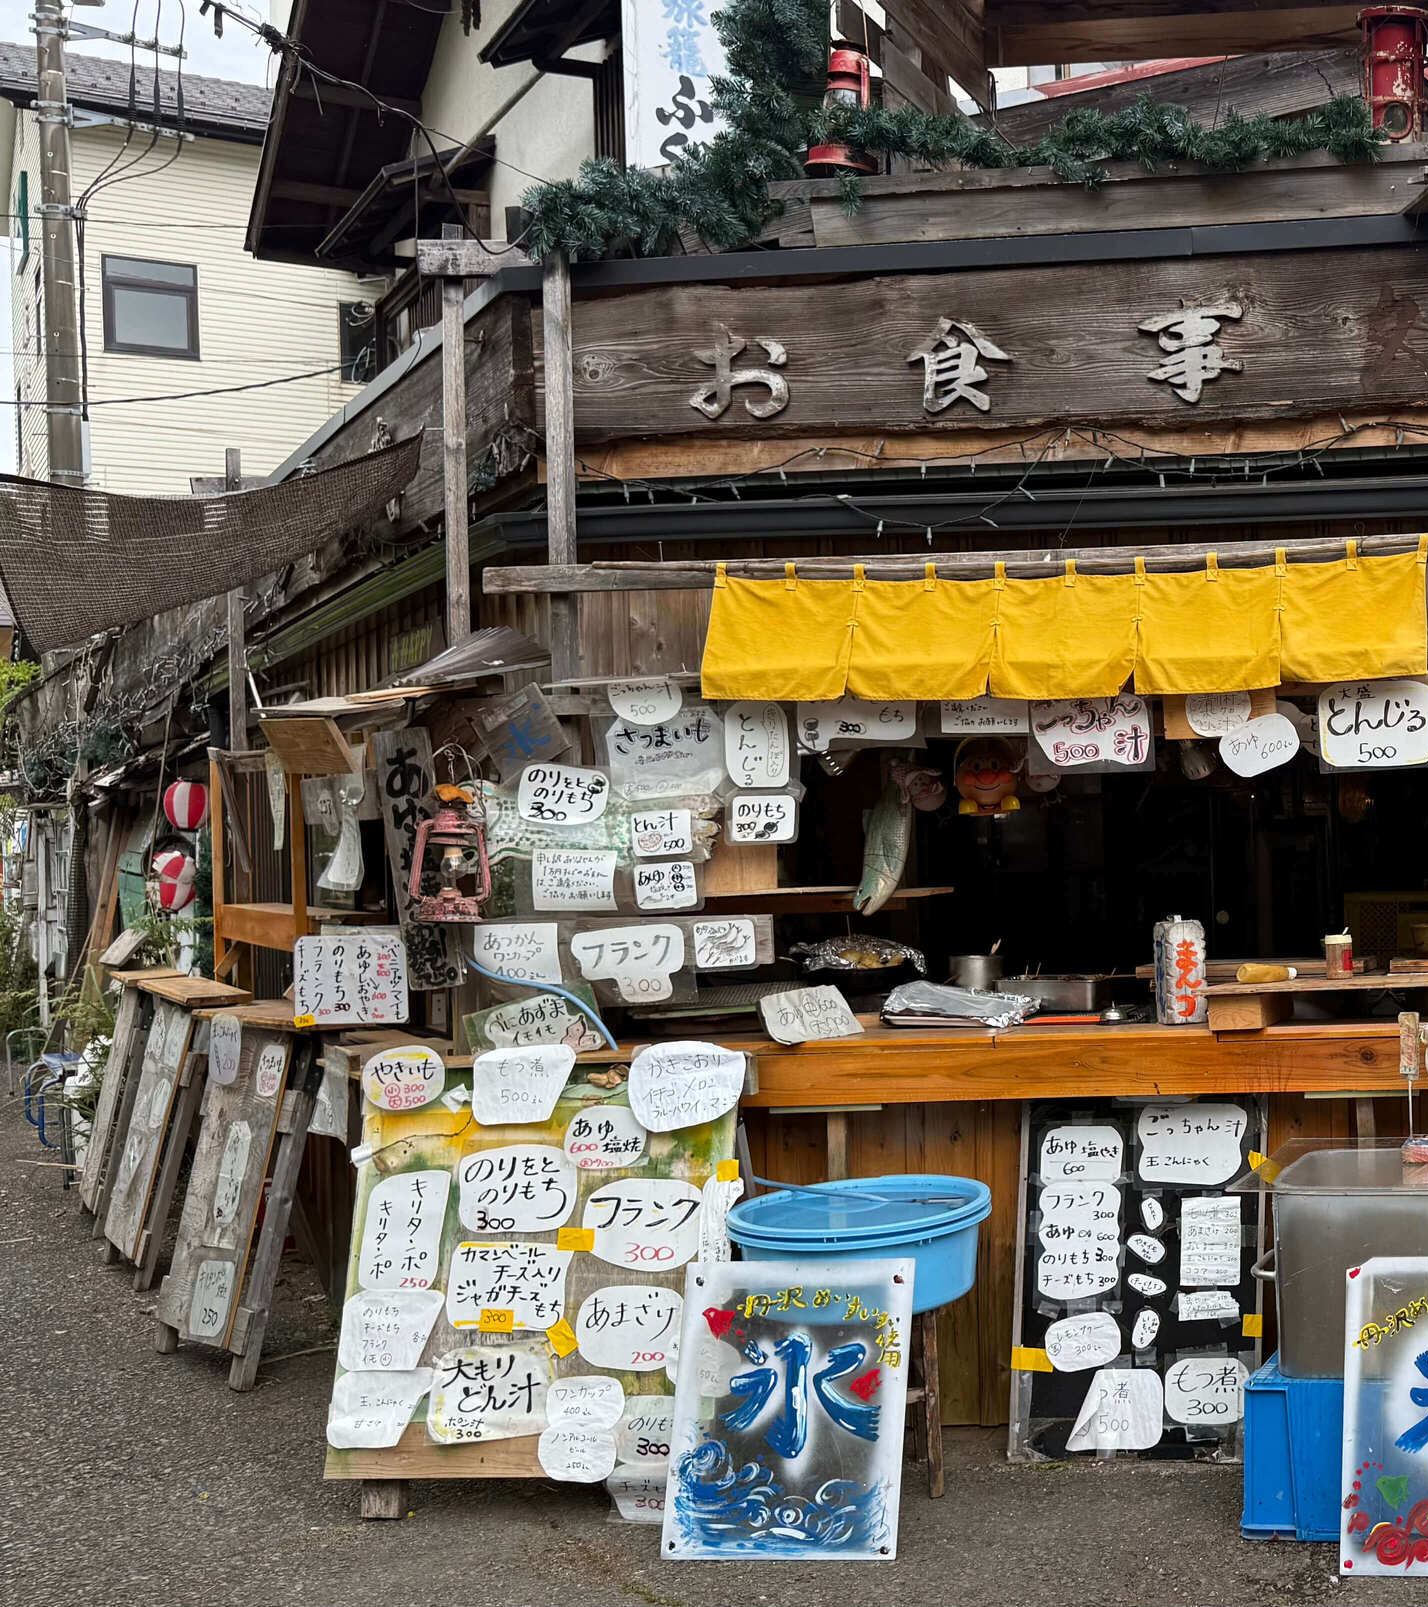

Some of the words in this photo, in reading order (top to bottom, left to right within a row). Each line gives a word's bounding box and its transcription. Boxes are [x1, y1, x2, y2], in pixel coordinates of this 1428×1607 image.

[1339, 684, 1376, 700] 大盛
[631, 704, 657, 717] 500
[615, 718, 711, 755] さつまいも
[1114, 726, 1149, 761] 汁
[738, 713, 763, 787] とんじる
[1053, 741, 1100, 763] 500
[1357, 742, 1397, 763] 500
[533, 787, 594, 812] のりもち
[528, 801, 568, 821] 300
[738, 803, 787, 820] のりもち
[634, 811, 679, 833] とん汁
[736, 821, 757, 833] 300
[663, 838, 686, 851] 500
[483, 931, 544, 951] あつかん
[582, 934, 671, 968] フランク
[494, 947, 542, 961] ワンカップ
[312, 945, 324, 1014] フランク
[332, 945, 345, 1002] のりもち
[622, 977, 662, 996] 300
[334, 1002, 351, 1012] 300
[489, 998, 567, 1032] べにあずま
[512, 1024, 557, 1047] イモイモ
[370, 1058, 437, 1085] やきいも
[498, 1056, 550, 1078] もつ煮
[404, 1083, 425, 1094] 300
[405, 1095, 427, 1107] 500
[572, 1118, 614, 1141] あゆ
[1146, 1114, 1244, 1138] ごっちゃん汁
[569, 1142, 599, 1155] 600
[602, 1135, 642, 1153] 塩焼
[1046, 1136, 1120, 1159] あゆ塩やき
[465, 1156, 560, 1183] のりをと
[1063, 1162, 1086, 1175] 600
[478, 1177, 567, 1220] のりもち
[1046, 1190, 1105, 1210] フランク
[401, 1178, 429, 1271] キリタンポ
[476, 1210, 516, 1230] 300
[590, 1197, 701, 1232] フランク
[1092, 1210, 1115, 1221] 300
[369, 1199, 393, 1279] キリタンポ
[1096, 1231, 1116, 1242] 600
[460, 1243, 547, 1263] カマンベール
[624, 1242, 674, 1263] 300
[1042, 1249, 1091, 1266] のりもち
[1095, 1247, 1115, 1263] 300
[493, 1260, 561, 1284] チーズ入り
[1042, 1272, 1095, 1288] チーズもち
[1098, 1275, 1117, 1287] 300
[400, 1277, 429, 1288] 250
[457, 1279, 548, 1306] ジャガチーズ
[202, 1307, 218, 1327] 250
[363, 1306, 401, 1318] のりもち
[484, 1313, 507, 1324] 300
[535, 1300, 562, 1324] もち
[585, 1292, 679, 1342] あまざけ
[1056, 1323, 1106, 1341] レモンサワー
[362, 1339, 388, 1350] フランク
[631, 1351, 665, 1364] 200
[442, 1353, 516, 1389] 大もり
[1171, 1364, 1239, 1393] もつ煮
[554, 1384, 612, 1401] ワンカップ
[720, 1332, 882, 1459] 氷
[1187, 1399, 1229, 1416] 300
[1098, 1414, 1130, 1434] 500
[456, 1429, 482, 1440] 300
[636, 1437, 671, 1456] 300
